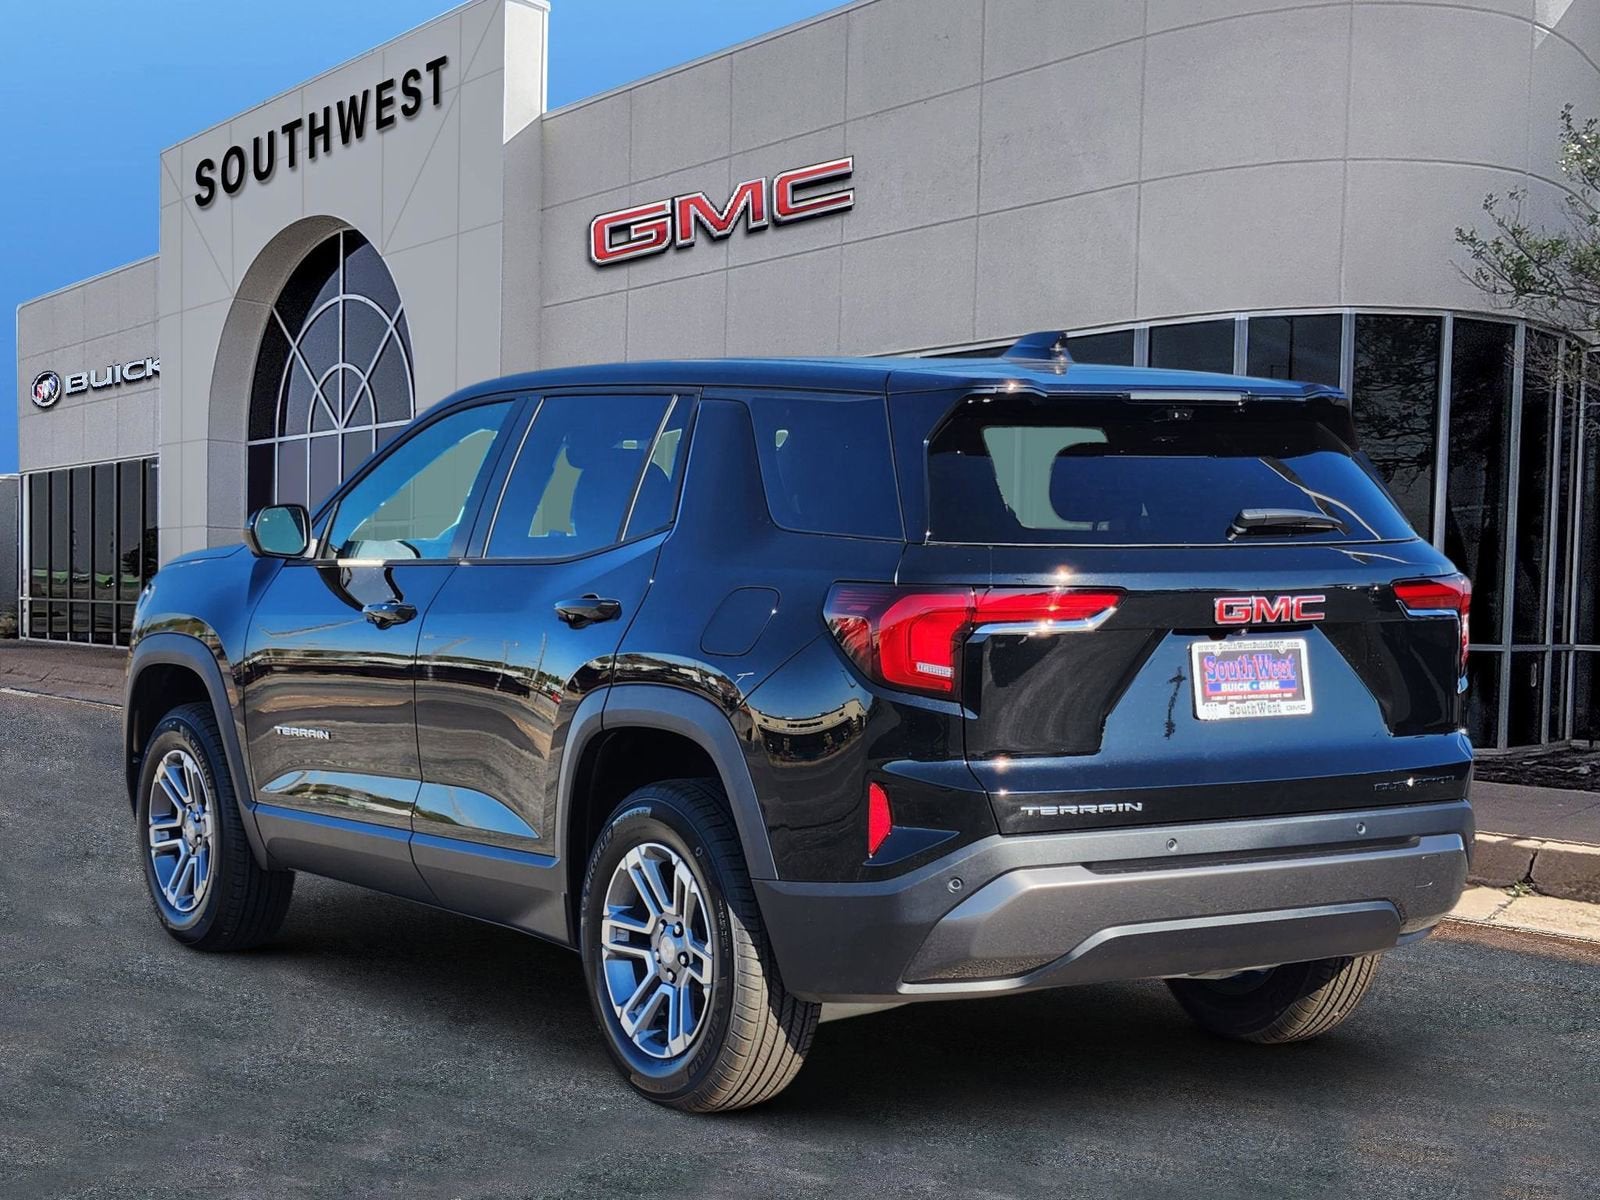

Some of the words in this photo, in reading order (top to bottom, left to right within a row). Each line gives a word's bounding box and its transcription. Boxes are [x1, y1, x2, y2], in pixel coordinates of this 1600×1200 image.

[194, 55, 448, 207] SOUTHWEST
[589, 155, 855, 266] GMC
[65, 358, 160, 395] BUICK
[1214, 595, 1326, 624] GMC
[1220, 681, 1249, 692] BUICK
[1259, 680, 1280, 691] GMC
[274, 726, 330, 740] TERRAIN
[1020, 802, 1143, 816] TERRAIN
